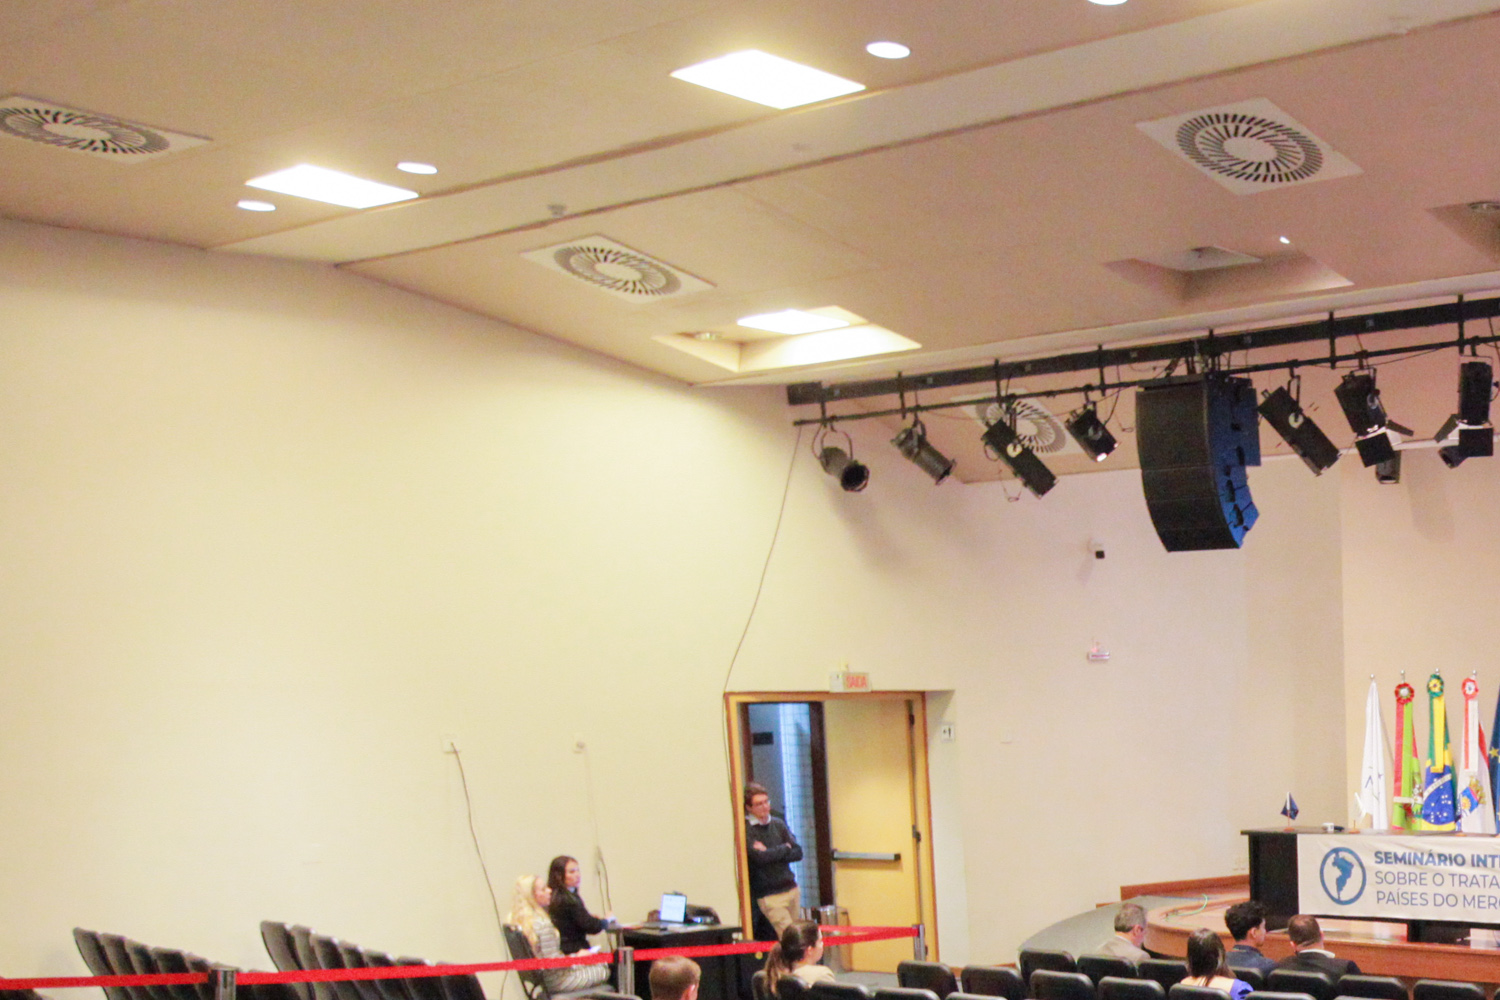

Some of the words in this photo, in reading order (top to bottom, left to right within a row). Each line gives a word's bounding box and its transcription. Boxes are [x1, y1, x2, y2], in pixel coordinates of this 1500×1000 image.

[1374, 850, 1466, 867] SEMINÁRIO
[1375, 870, 1428, 886] SOBRE
[1432, 873, 1445, 887] O
[1376, 888, 1429, 907] PAÍSES
[1433, 893, 1458, 908] DO
